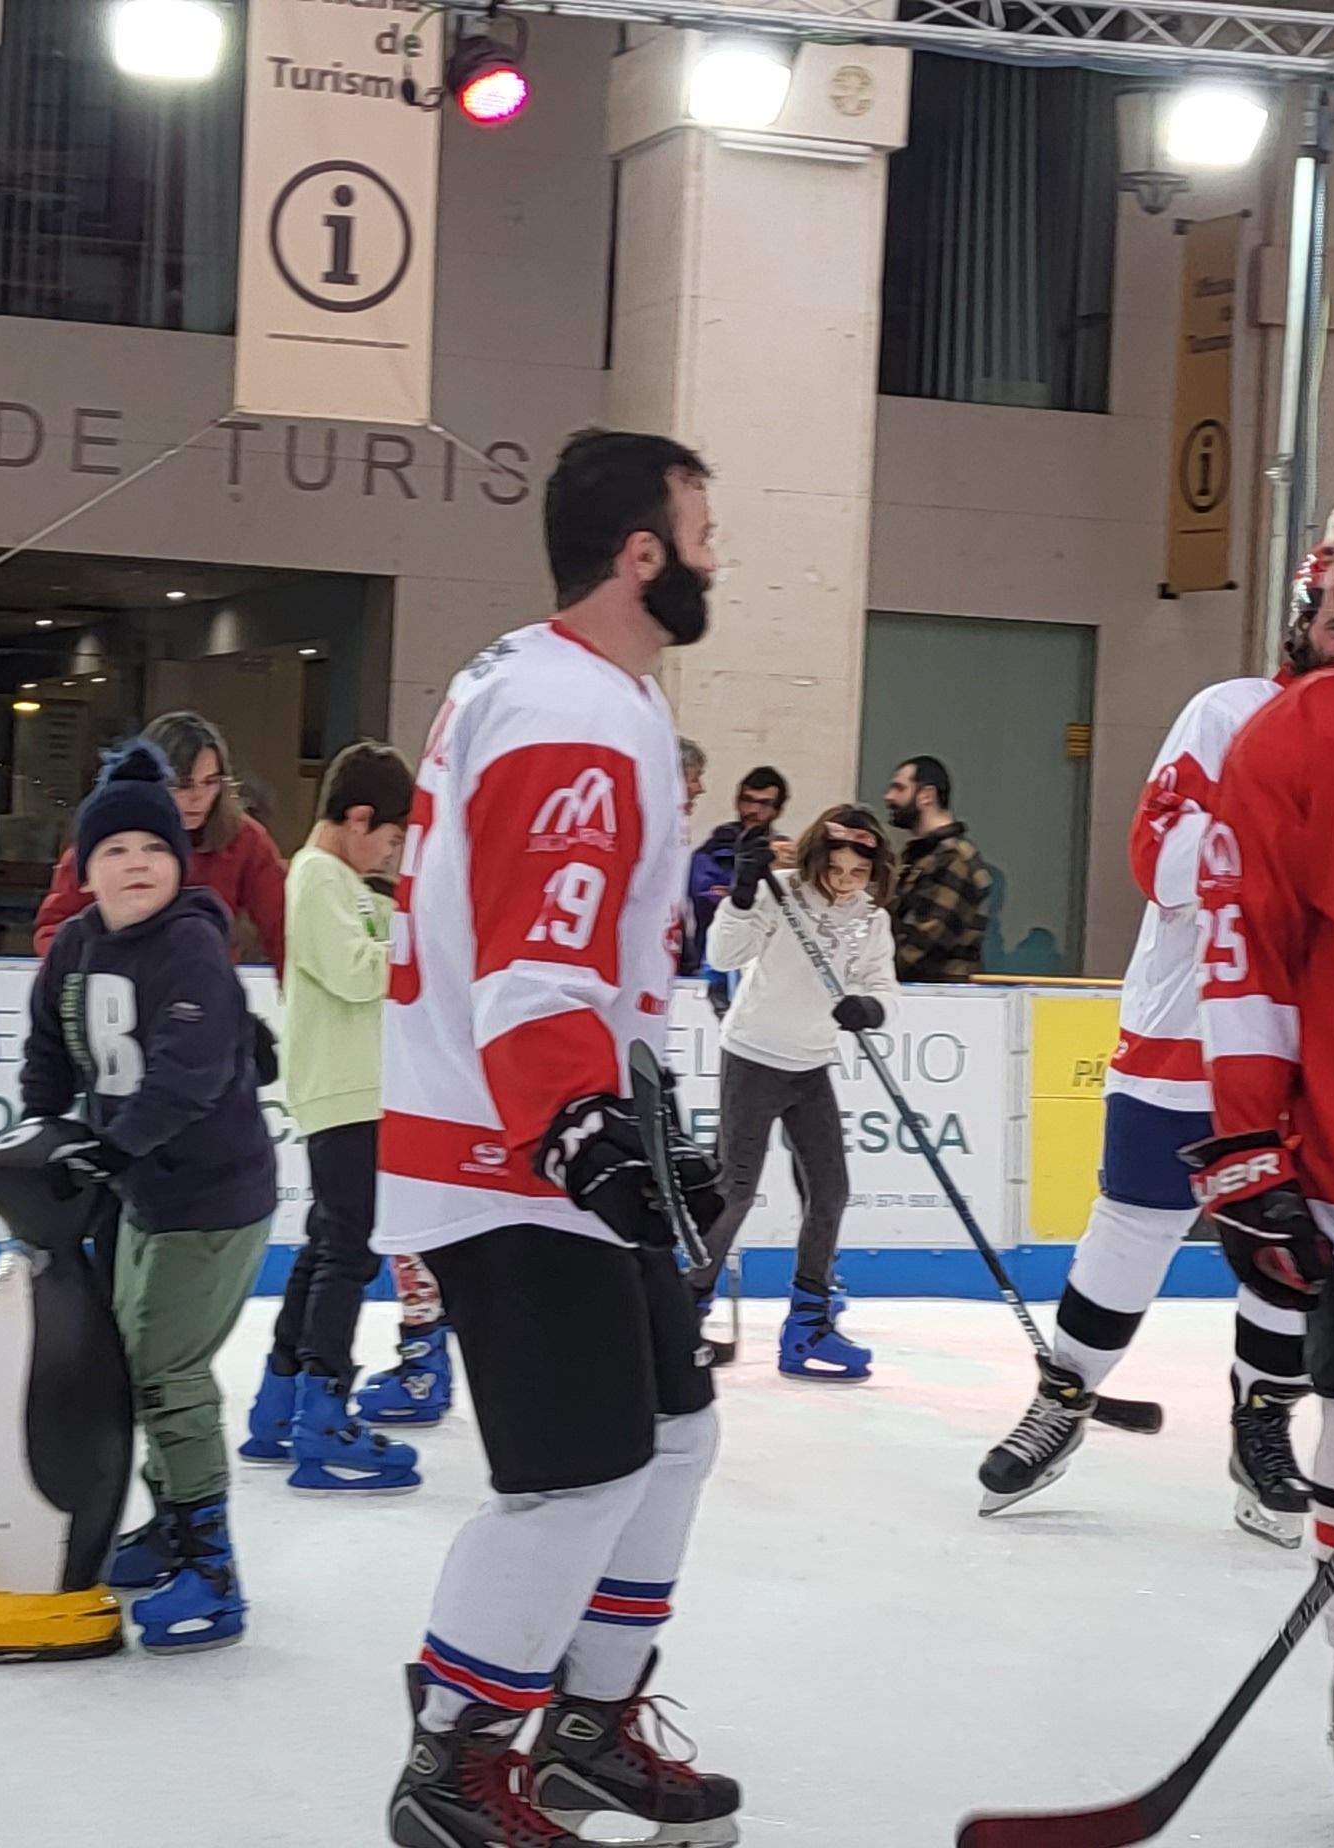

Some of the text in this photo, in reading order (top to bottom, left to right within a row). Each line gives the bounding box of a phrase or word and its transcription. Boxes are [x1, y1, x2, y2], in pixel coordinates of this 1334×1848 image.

[374, 23, 423, 57] de
[266, 55, 419, 102] Turism
[212, 419, 530, 505] TURIS
[524, 861, 607, 950] 19
[84, 972, 147, 1097] B
[839, 1110, 973, 1155] ESCA
[1193, 1152, 1282, 1206] UER
